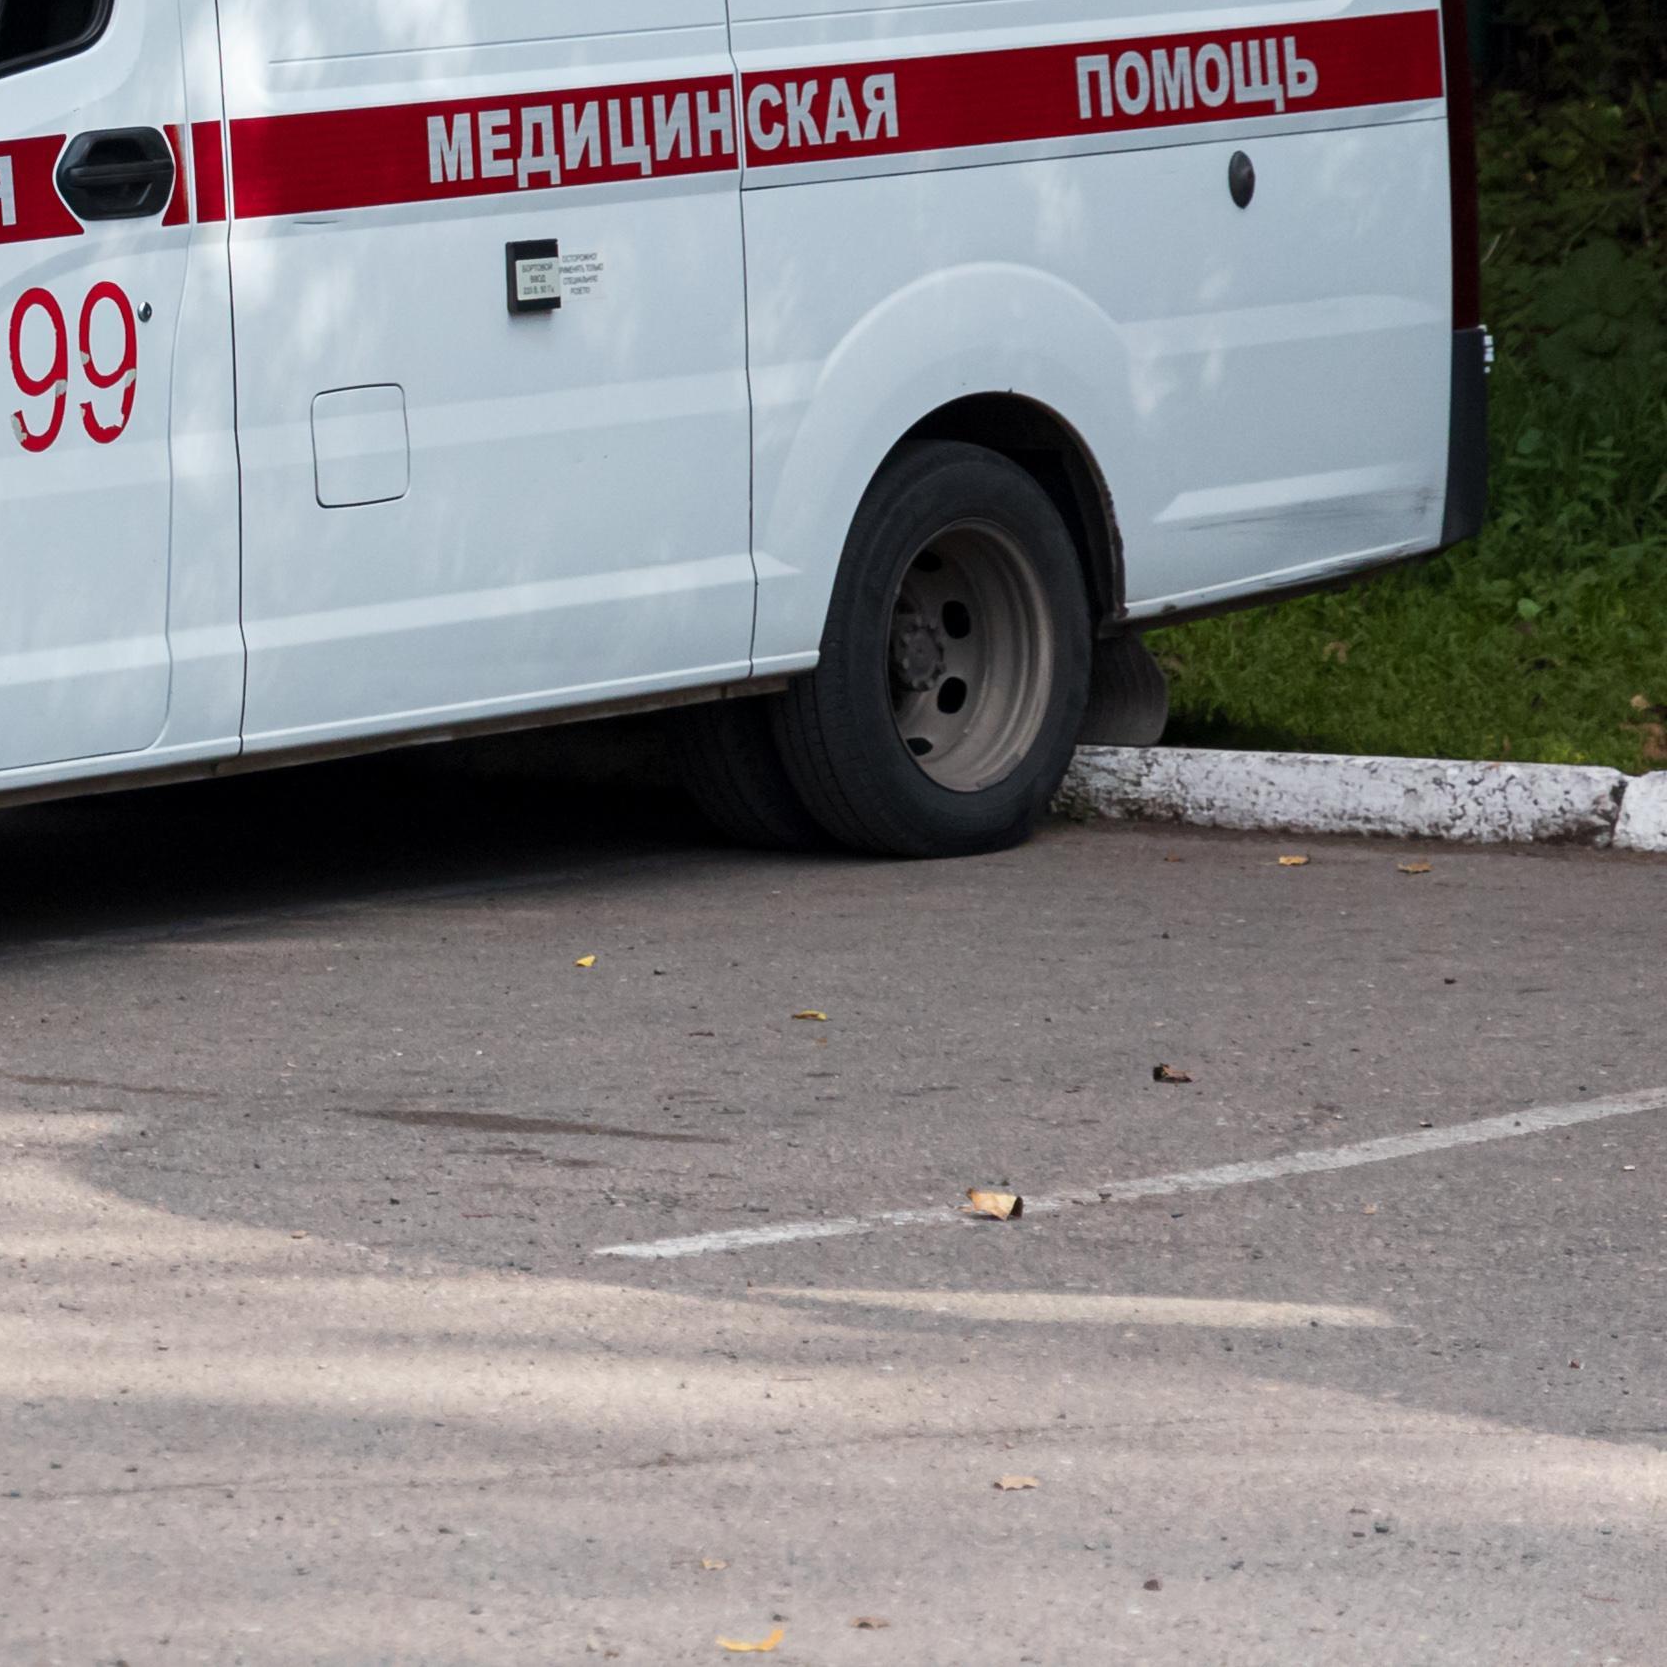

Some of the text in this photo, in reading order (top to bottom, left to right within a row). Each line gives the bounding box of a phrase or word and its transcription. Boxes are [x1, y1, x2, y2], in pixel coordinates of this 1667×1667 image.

[426, 72, 900, 188] МЕДИЦИНСКАЯ
[1075, 36, 1319, 119] ПОМОЩЬ
[8, 280, 138, 452] 99
